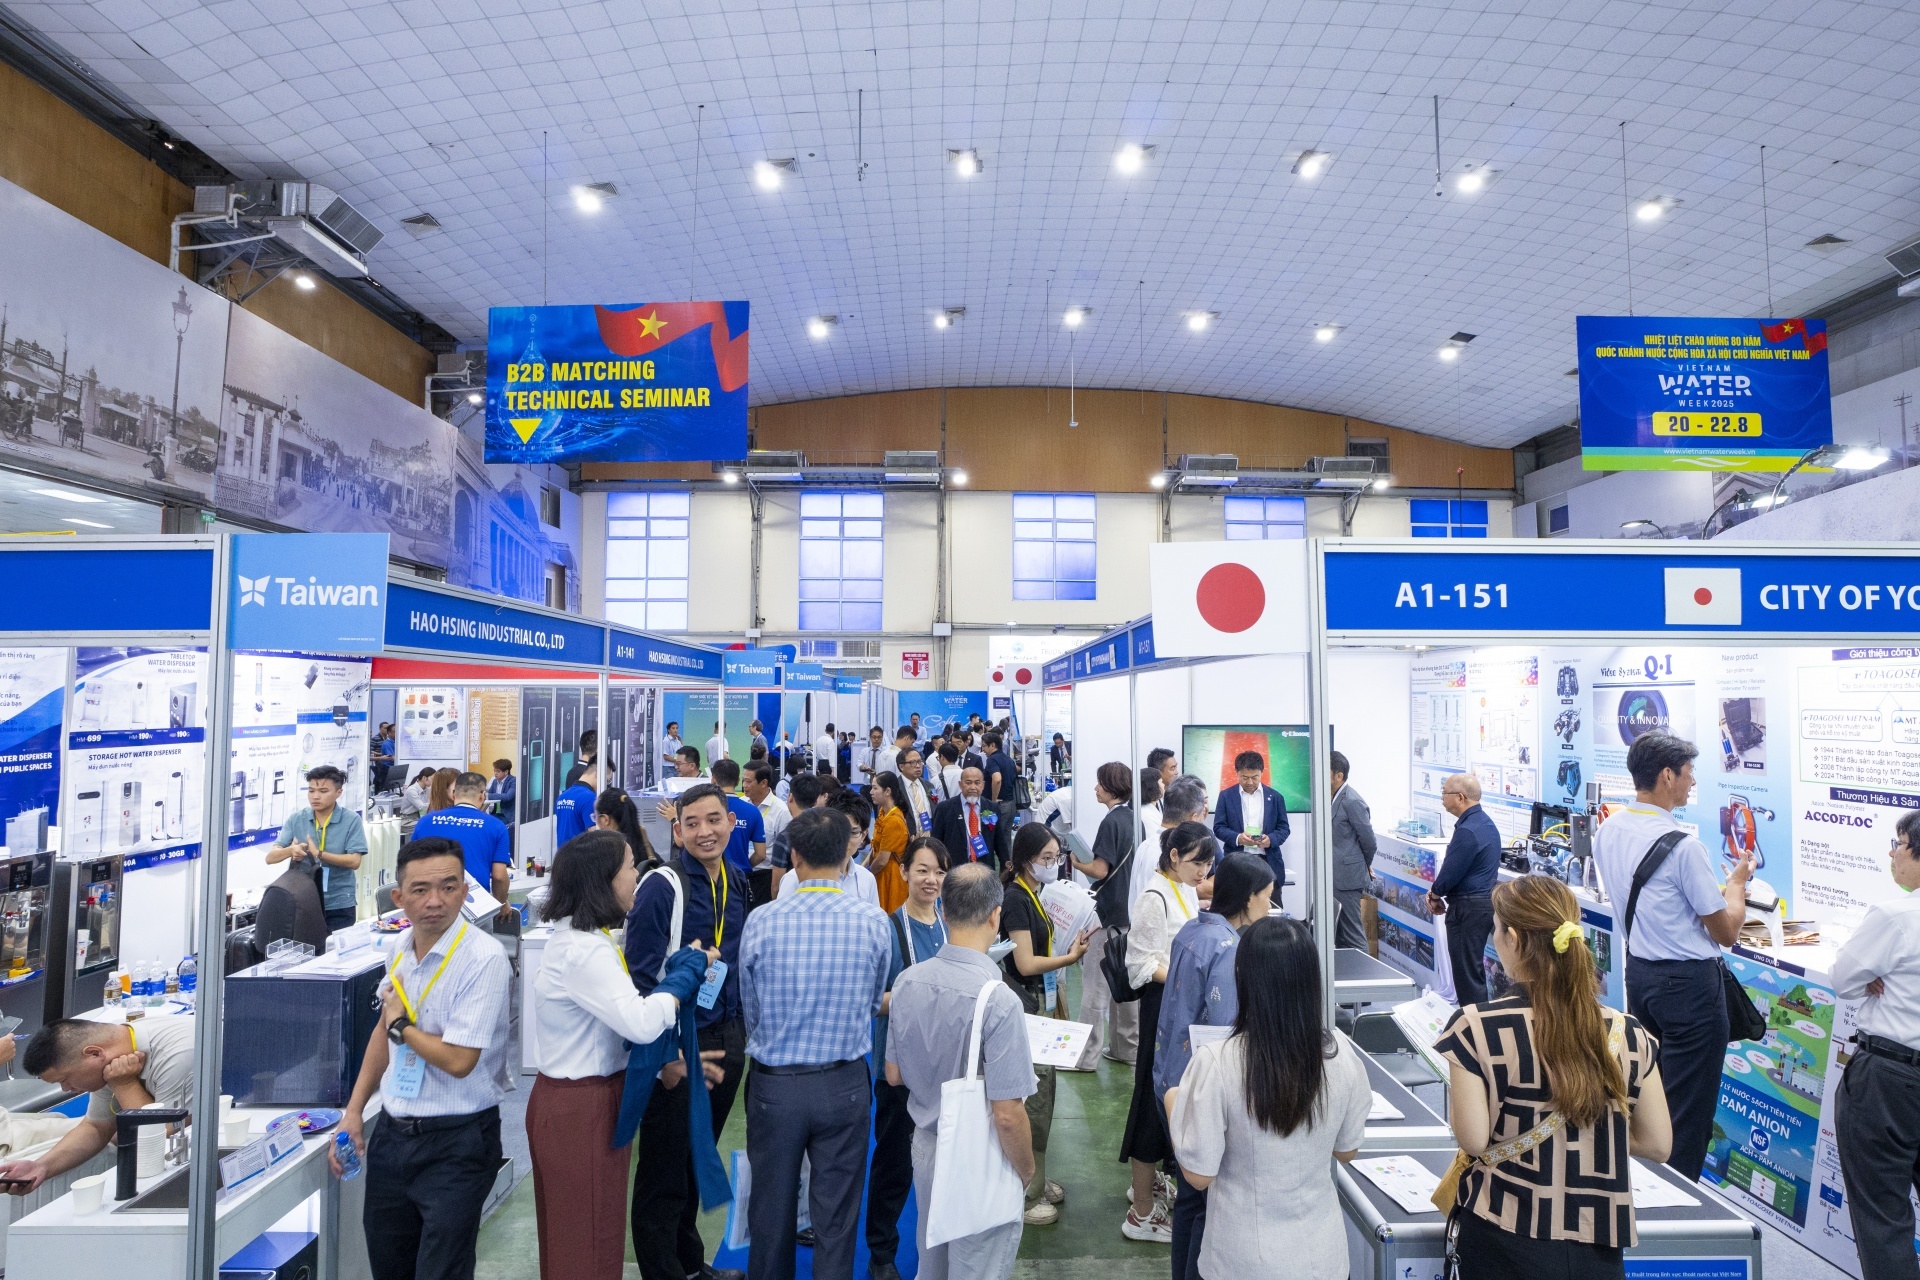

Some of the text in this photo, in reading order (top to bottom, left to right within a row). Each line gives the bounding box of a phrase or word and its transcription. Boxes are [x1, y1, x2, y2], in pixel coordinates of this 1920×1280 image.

[1644, 334, 1761, 347] NHIỆT LIỆT CHÀO MỪNG 80 NĂM
[1596, 345, 1810, 362] QUỐC KHÁNH NƯỚC CỘNG HÒA XÃ HỘI CHỦ NGHĨA VIỆT NAM
[507, 361, 655, 382] B2B MATCHING
[1658, 374, 1752, 396] WATER
[506, 387, 711, 410] TECHNICAL SEMINAR
[1668, 416, 1690, 432] 20
[1710, 416, 1748, 433] 22.8
[1664, 448, 1756, 456] www.vietnamwaterweek.vn
[275, 576, 378, 607] Taiwan
[1395, 582, 1508, 608] A1-151
[1760, 584, 1920, 610] CITY OF YO
[410, 610, 564, 650] HAO HSING INDUSTRIAL CO., LTD
[616, 645, 634, 659] A1-141
[648, 650, 658, 663] HAO
[659, 652, 671, 664] HSING
[1736, 653, 1758, 661] product
[1850, 649, 1866, 658] Giới
[1868, 648, 1888, 659] thiệu
[1890, 648, 1912, 658] công
[738, 664, 773, 674] Taiwan
[1600, 668, 1616, 676] Video
[796, 672, 821, 680] Taiwan
[1630, 716, 1635, 724] &
[76, 734, 102, 743] HM-699
[0, 752, 52, 762] ATER DISPENSER
[88, 753, 118, 761] STORAGE
[154, 748, 182, 757] DISPENSER
[4, 762, 52, 773] PUBLIC SPACES
[1890, 778, 1920, 787] Toagosei
[1836, 790, 1919, 807] Thương Hiệu & Sản
[432, 815, 484, 824] HAOHSING
[1805, 810, 1873, 828] ACCOFLOC
[124, 858, 136, 866] 40A
[1754, 953, 1765, 962] ỨNG
[1724, 1082, 1802, 1127] LÝ NƯỚC SẠCH TIÊN TIẾN
[1721, 1094, 1790, 1140] PAM ANION
[1822, 1128, 1834, 1138] QUY
[1752, 1133, 1767, 1147] NSF
[1740, 1145, 1754, 1157] ACH
[1758, 1154, 1772, 1168] PAM
[1773, 1162, 1795, 1181] ANION
[1746, 1196, 1802, 1234] TOAGOSEI VIETNAM
[1828, 1204, 1839, 1214] trộn
